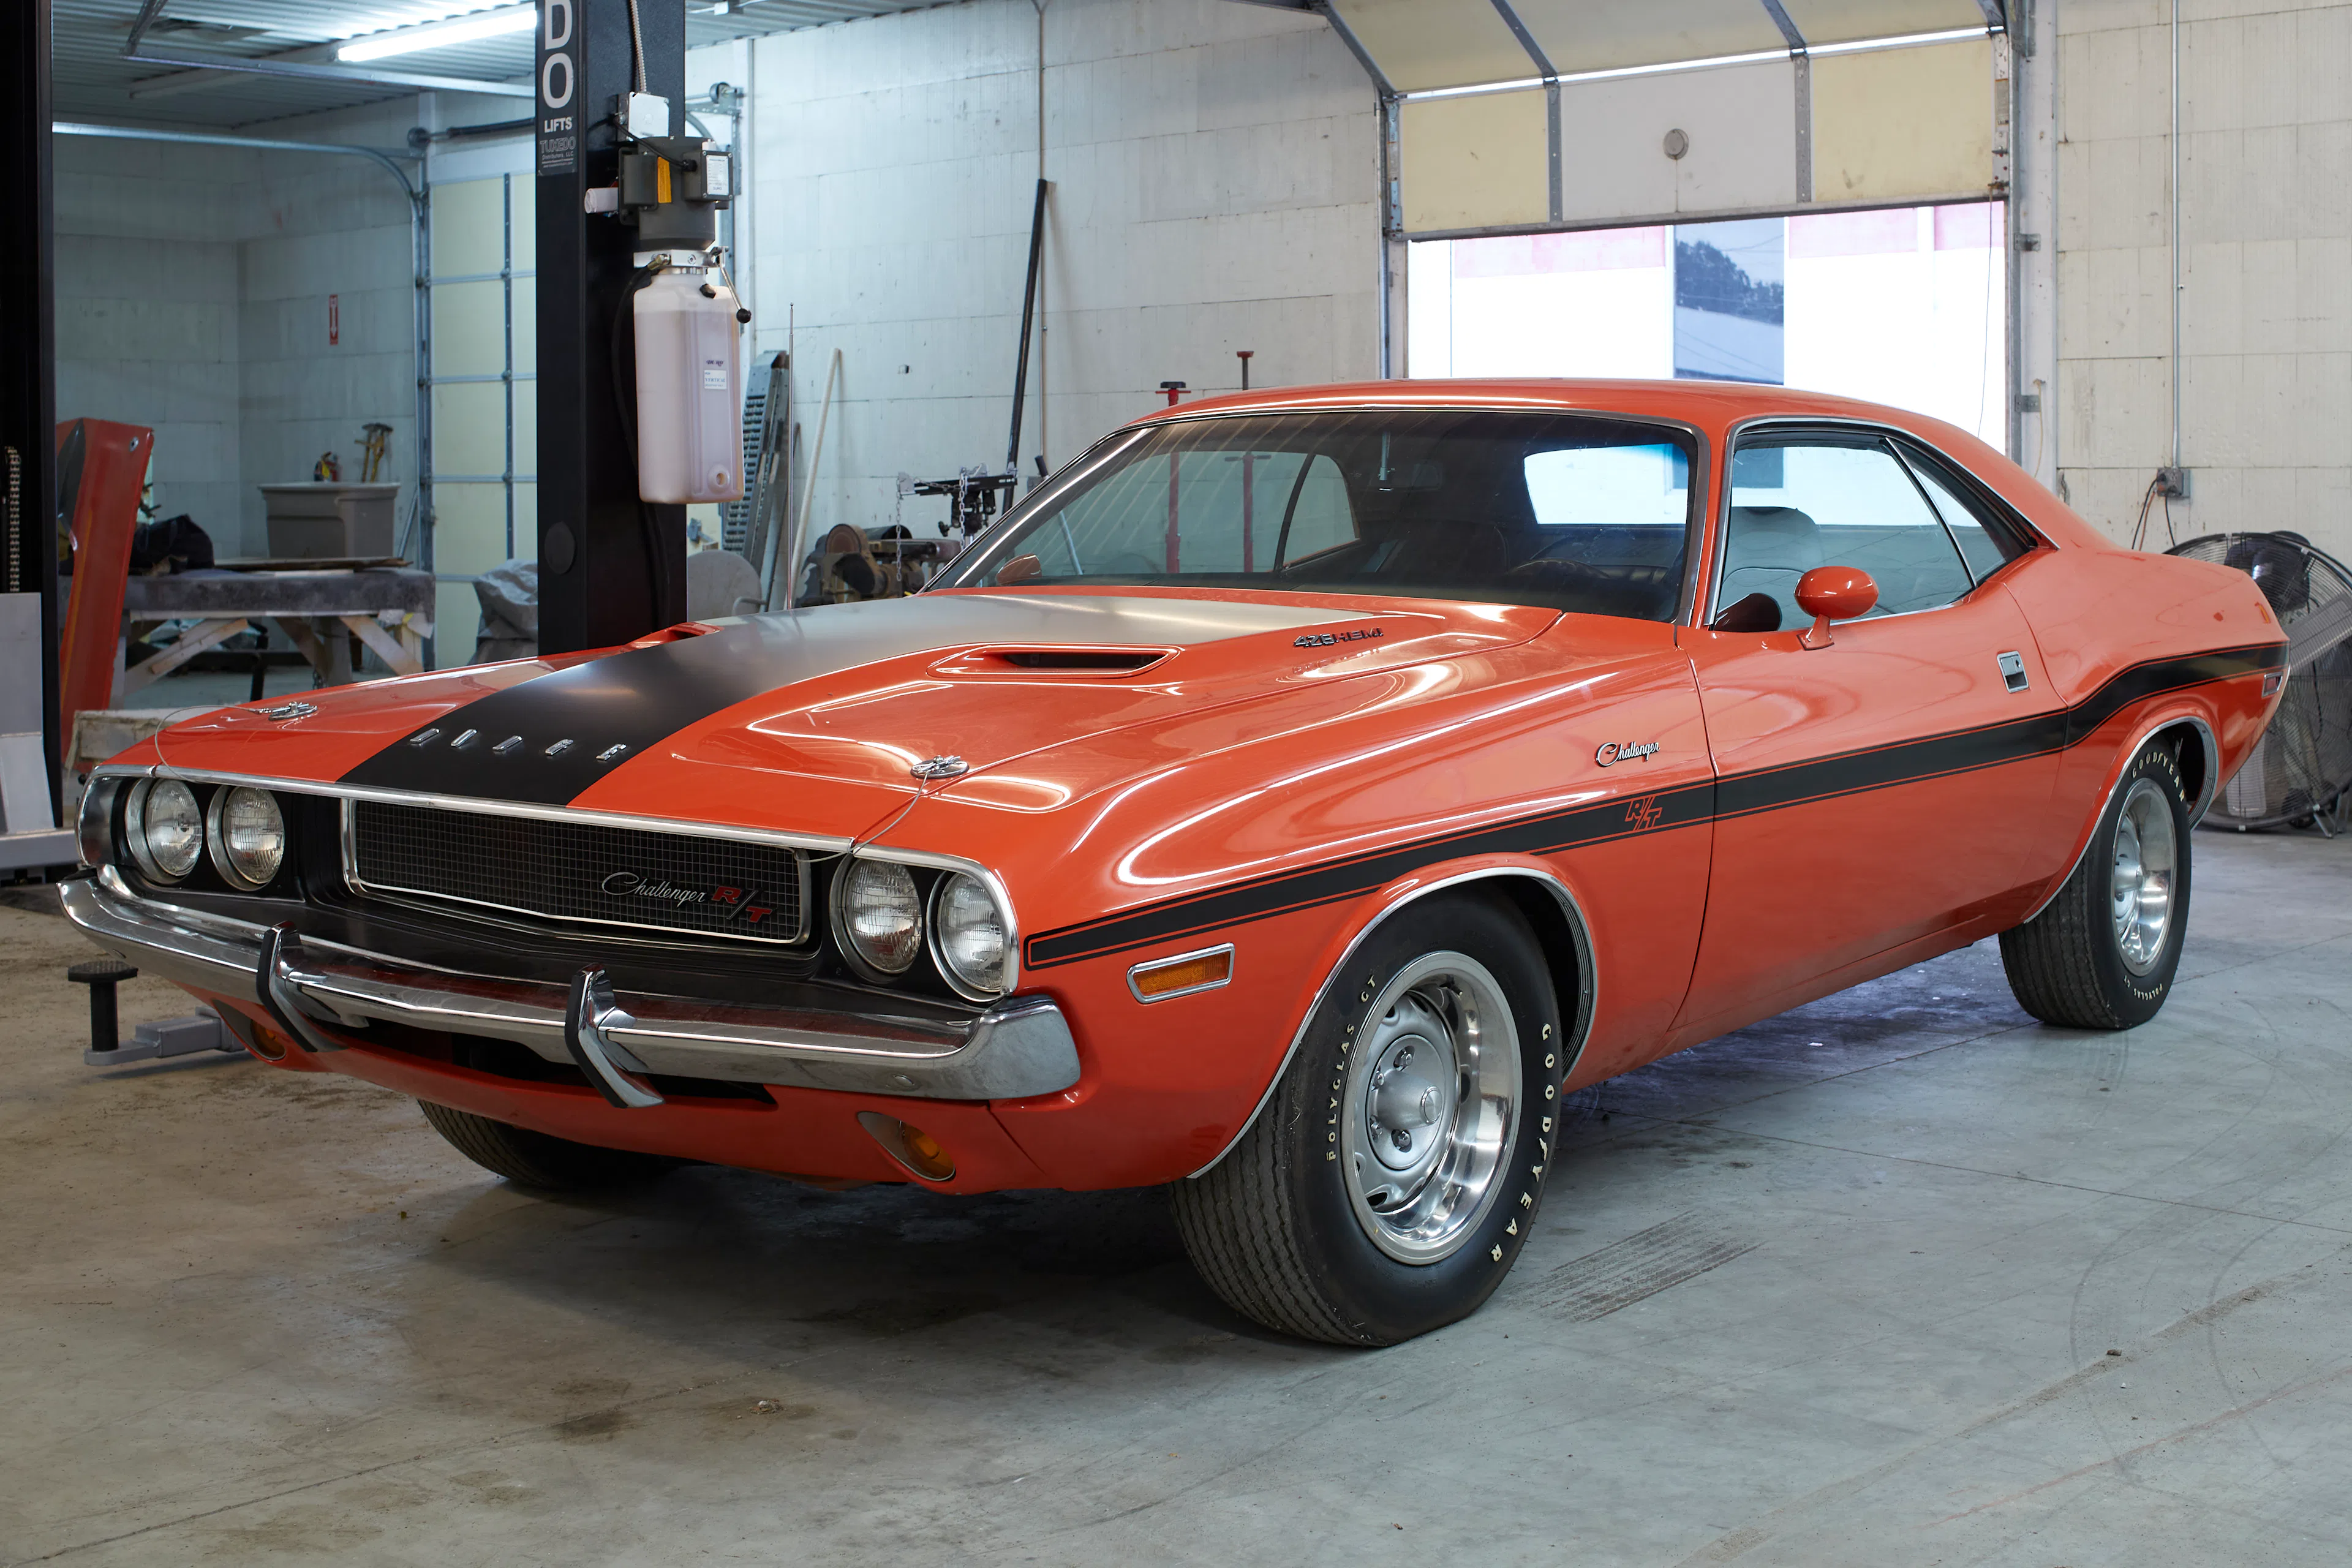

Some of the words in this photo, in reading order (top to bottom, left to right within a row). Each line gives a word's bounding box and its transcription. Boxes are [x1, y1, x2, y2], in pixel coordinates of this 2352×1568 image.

[540, 136, 576, 154] TUXEDO
[544, 116, 573, 133] LIFTS
[1596, 741, 1661, 767] Challenger
[2132, 752, 2185, 802] GOODYEAR
[1624, 796, 1663, 832] R/T
[601, 872, 707, 908] Challenger
[711, 885, 773, 924] R/T
[1325, 1023, 1355, 1161] POLYGLAS
[1360, 974, 1376, 1003] GT
[1488, 1022, 1555, 1262] GOODYEAR
